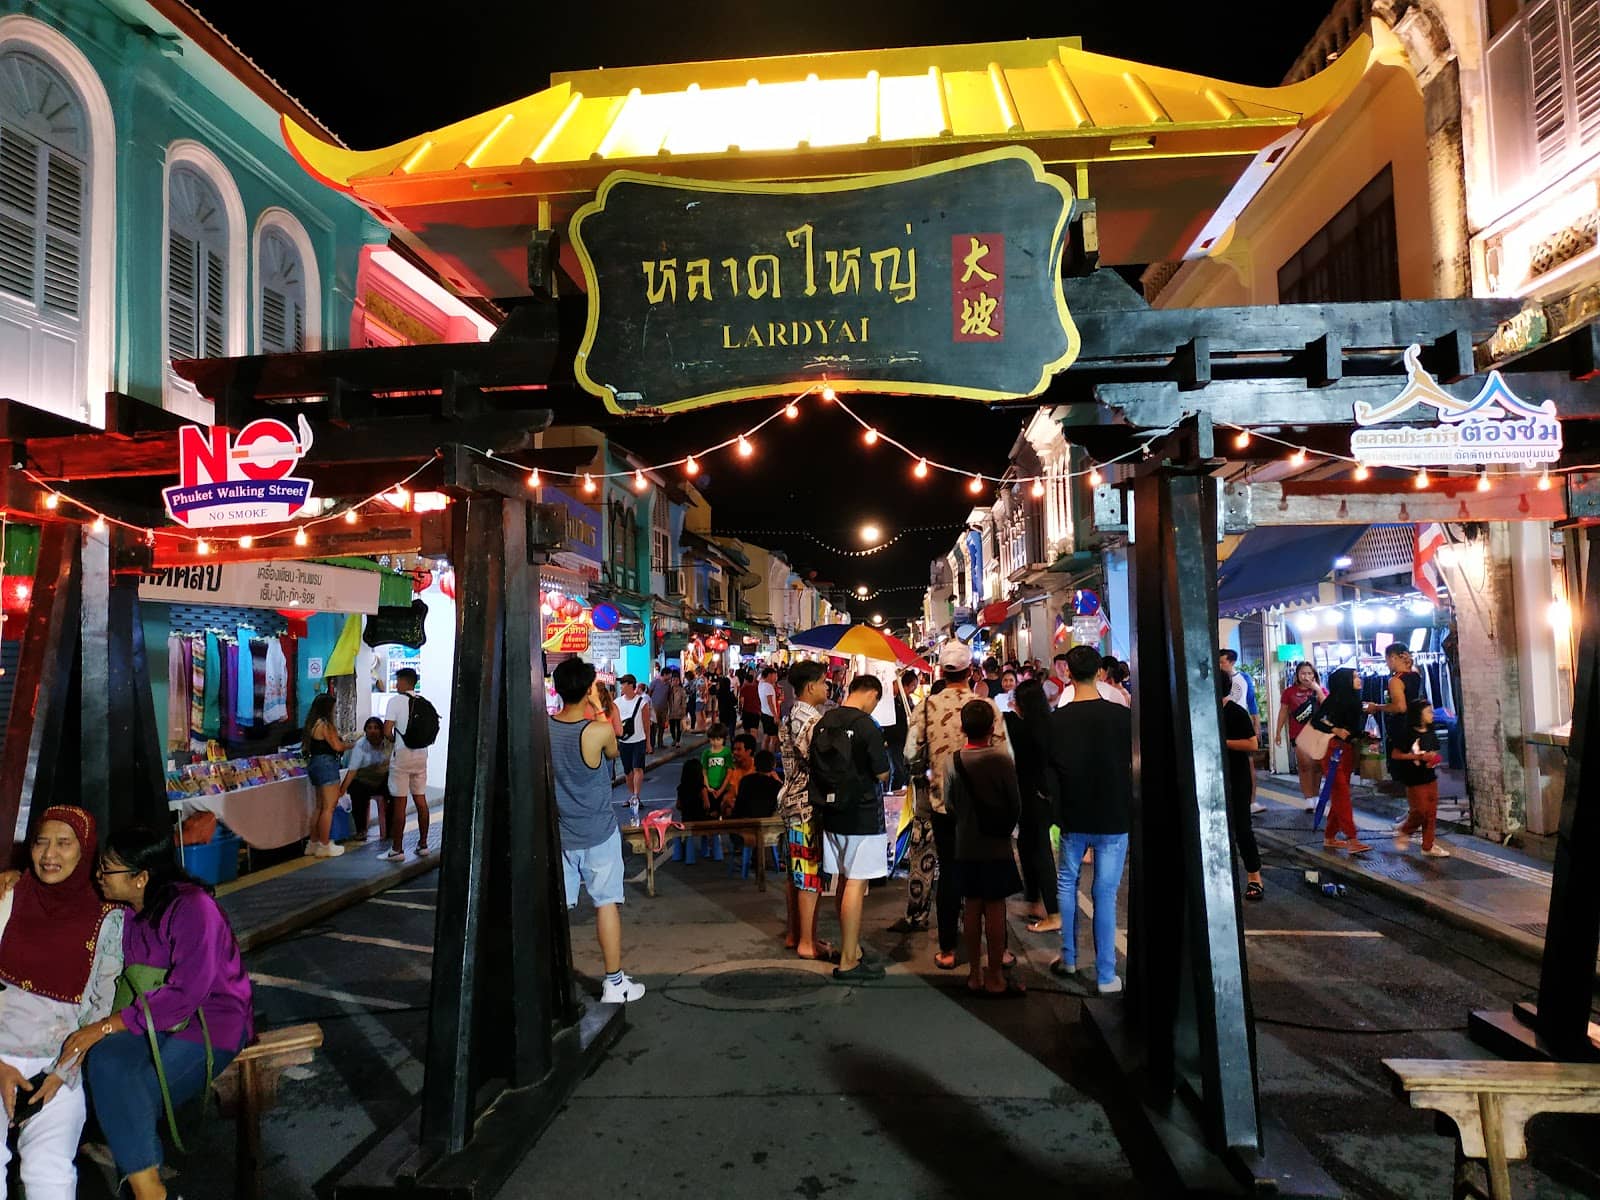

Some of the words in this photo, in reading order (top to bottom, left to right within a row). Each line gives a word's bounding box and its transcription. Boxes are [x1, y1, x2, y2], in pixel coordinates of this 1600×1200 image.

[642, 223, 918, 304] หลาดใหญ่
[960, 236, 998, 338] 大坡
[721, 316, 870, 350] LARDYAI
[1461, 416, 1557, 441] ต้องชม
[183, 421, 294, 487] NO
[172, 488, 213, 506] Phuket
[217, 486, 264, 498] Walking
[269, 484, 304, 497] Street
[209, 511, 224, 520] NO
[228, 508, 268, 519] SMOKE
